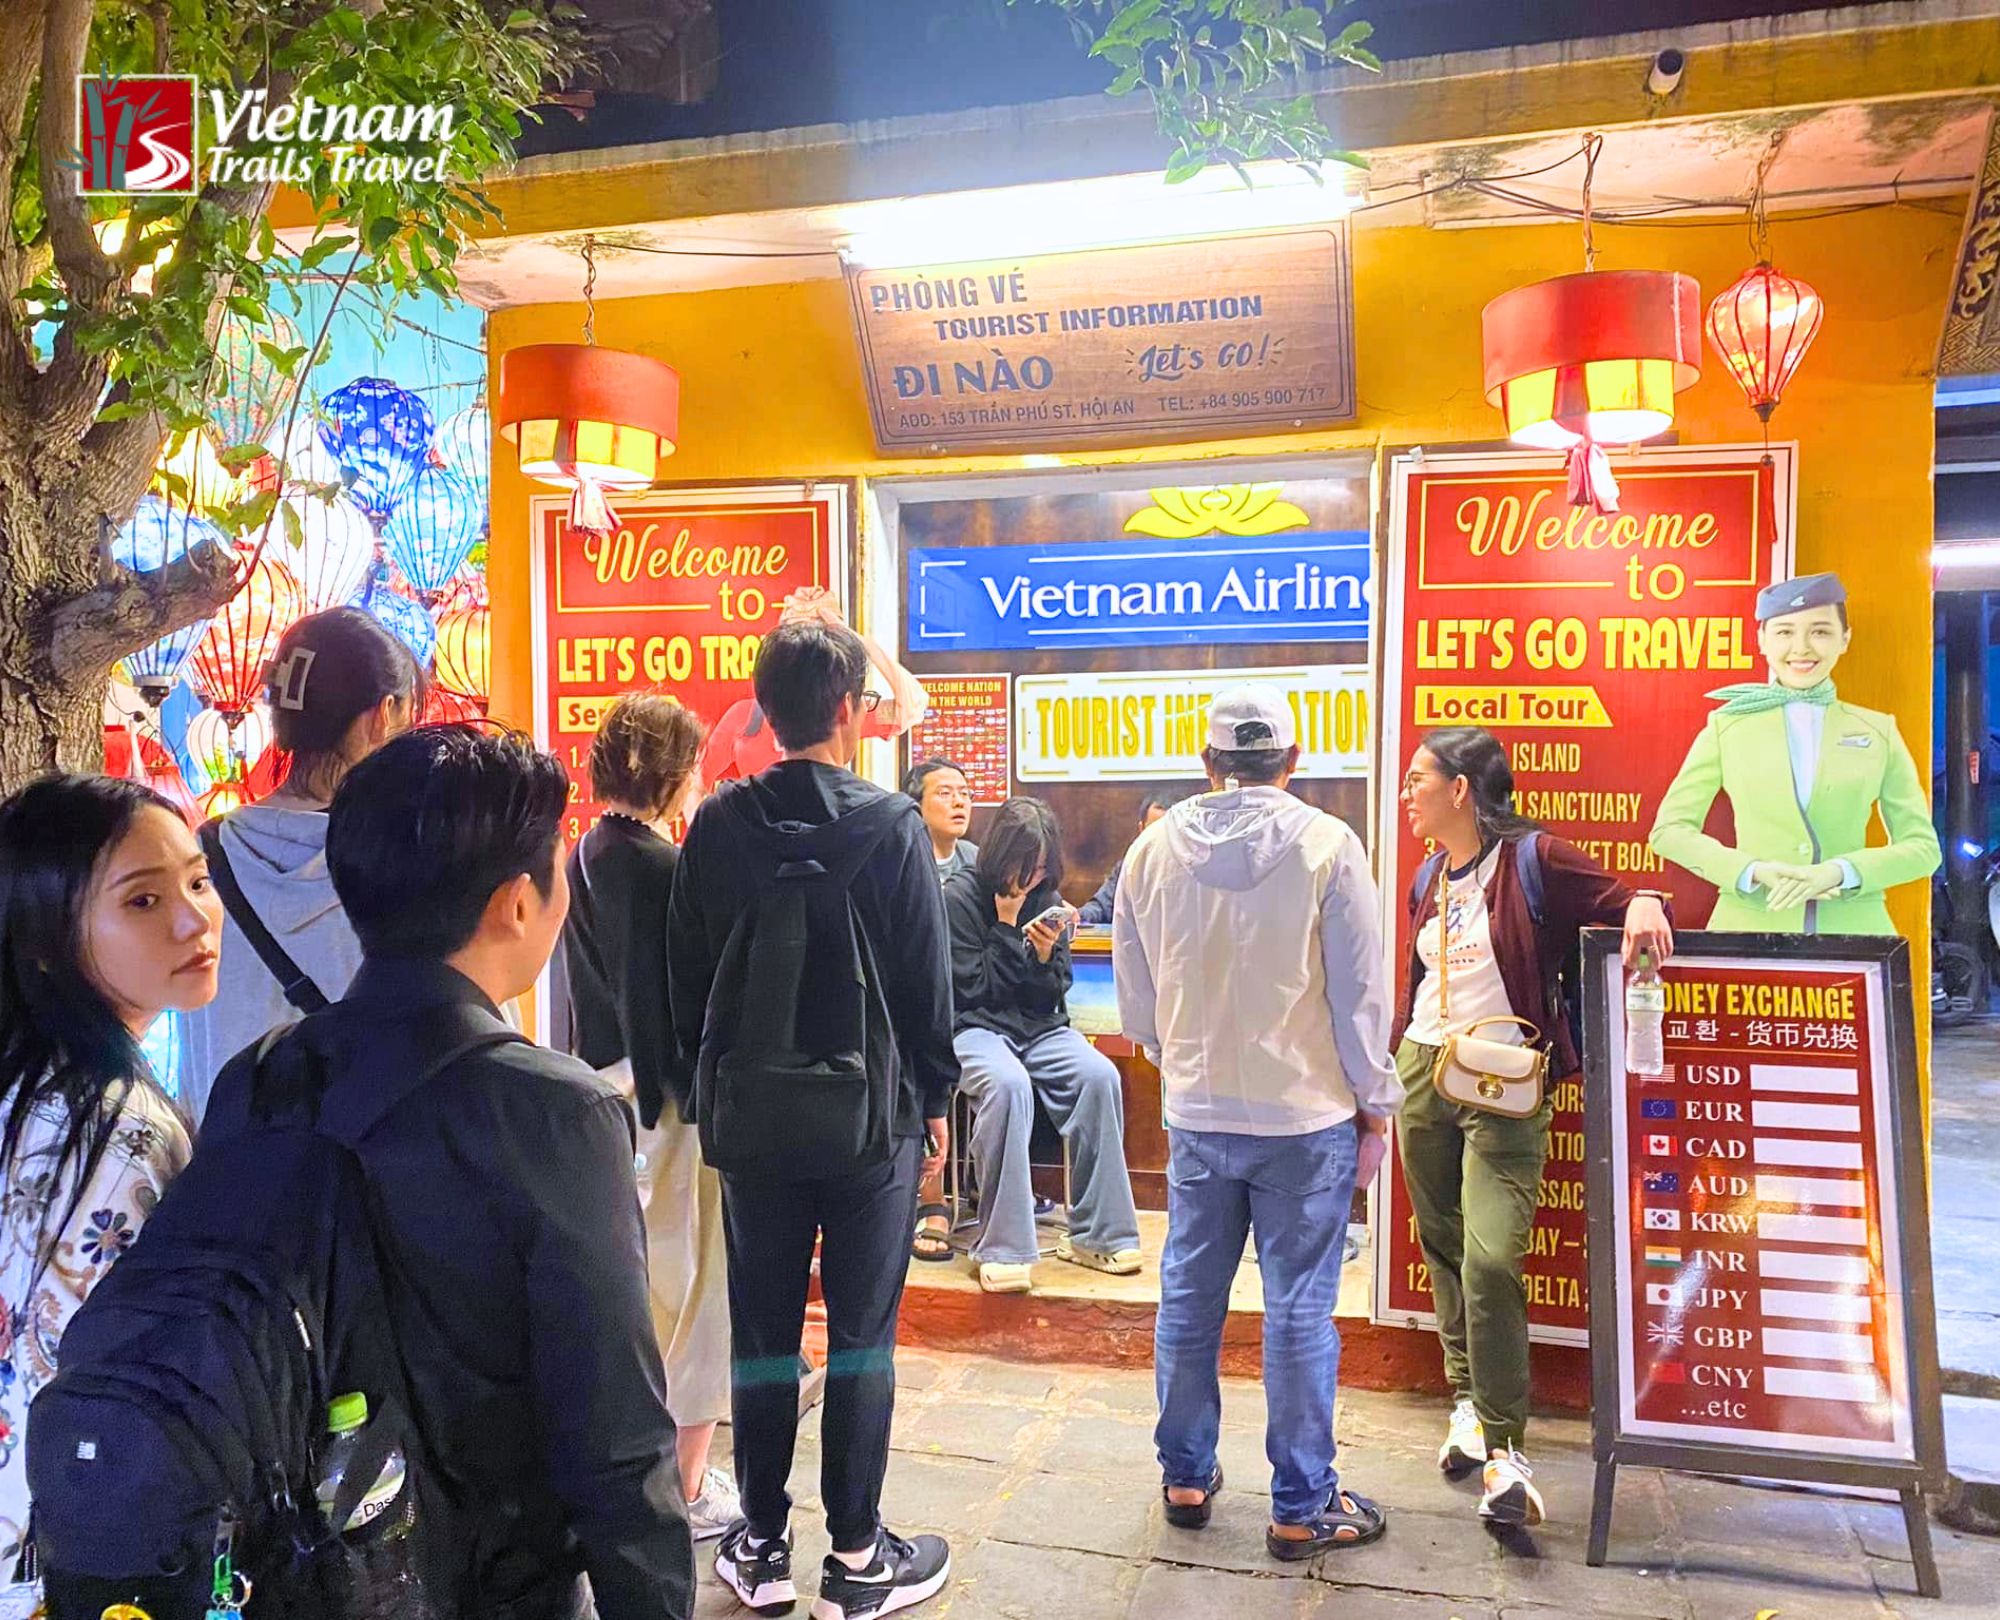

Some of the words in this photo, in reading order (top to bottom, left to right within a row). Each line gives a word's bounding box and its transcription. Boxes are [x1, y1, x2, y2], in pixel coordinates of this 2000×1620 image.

[870, 273, 979, 313] PHÒNG
[988, 266, 1028, 304] VÉ
[933, 312, 1049, 341] TOURIST
[1061, 295, 1263, 332] INFORMATION
[893, 363, 942, 398] ĐI
[954, 348, 1053, 394] NÀO
[1138, 343, 1205, 383] Let's
[941, 410, 965, 426] 153
[1016, 400, 1048, 421] PHÚ
[1052, 404, 1076, 419] ST.
[1080, 396, 1108, 420] HỘI
[1113, 400, 1135, 415] AN
[1158, 397, 1194, 412] TEL:
[1200, 394, 1227, 409] +84
[1232, 391, 1260, 408] 905
[1265, 389, 1293, 405] 900
[1297, 387, 1325, 402] 717
[1456, 489, 1718, 557] Welcome
[584, 524, 789, 583] Welcome
[1626, 553, 1686, 601] to
[719, 580, 766, 621] to
[981, 576, 1203, 619] Vietnam
[558, 637, 635, 683] LET'S
[643, 636, 693, 682] GO
[701, 635, 765, 680] TRA
[1417, 619, 1514, 669] LET'S
[1524, 617, 1588, 669] GO
[1599, 617, 1753, 669] TRAVEL
[939, 696, 957, 706] THE
[958, 695, 993, 706] WORLD
[966, 681, 1001, 692] NATION
[1426, 693, 1507, 719] Local
[1519, 693, 1589, 719] Tour
[1036, 693, 1157, 759] TOURIST
[1512, 742, 1581, 773] ISLAND
[1527, 790, 1642, 823] SANCTUARY
[1663, 982, 1719, 1015] ONEY
[1726, 984, 1856, 1020] EXCHANGE
[1746, 1020, 1859, 1050] 货币兑换
[1686, 1065, 1741, 1086] USD
[1685, 1101, 1744, 1122] EUR
[1685, 1137, 1747, 1159] CAD
[1688, 1174, 1748, 1196] AUD
[1691, 1212, 1752, 1234] KRW
[1695, 1250, 1747, 1272] INR
[1695, 1287, 1748, 1310] JPY
[1694, 1326, 1753, 1349] GBP
[1691, 1364, 1753, 1389] CNY
